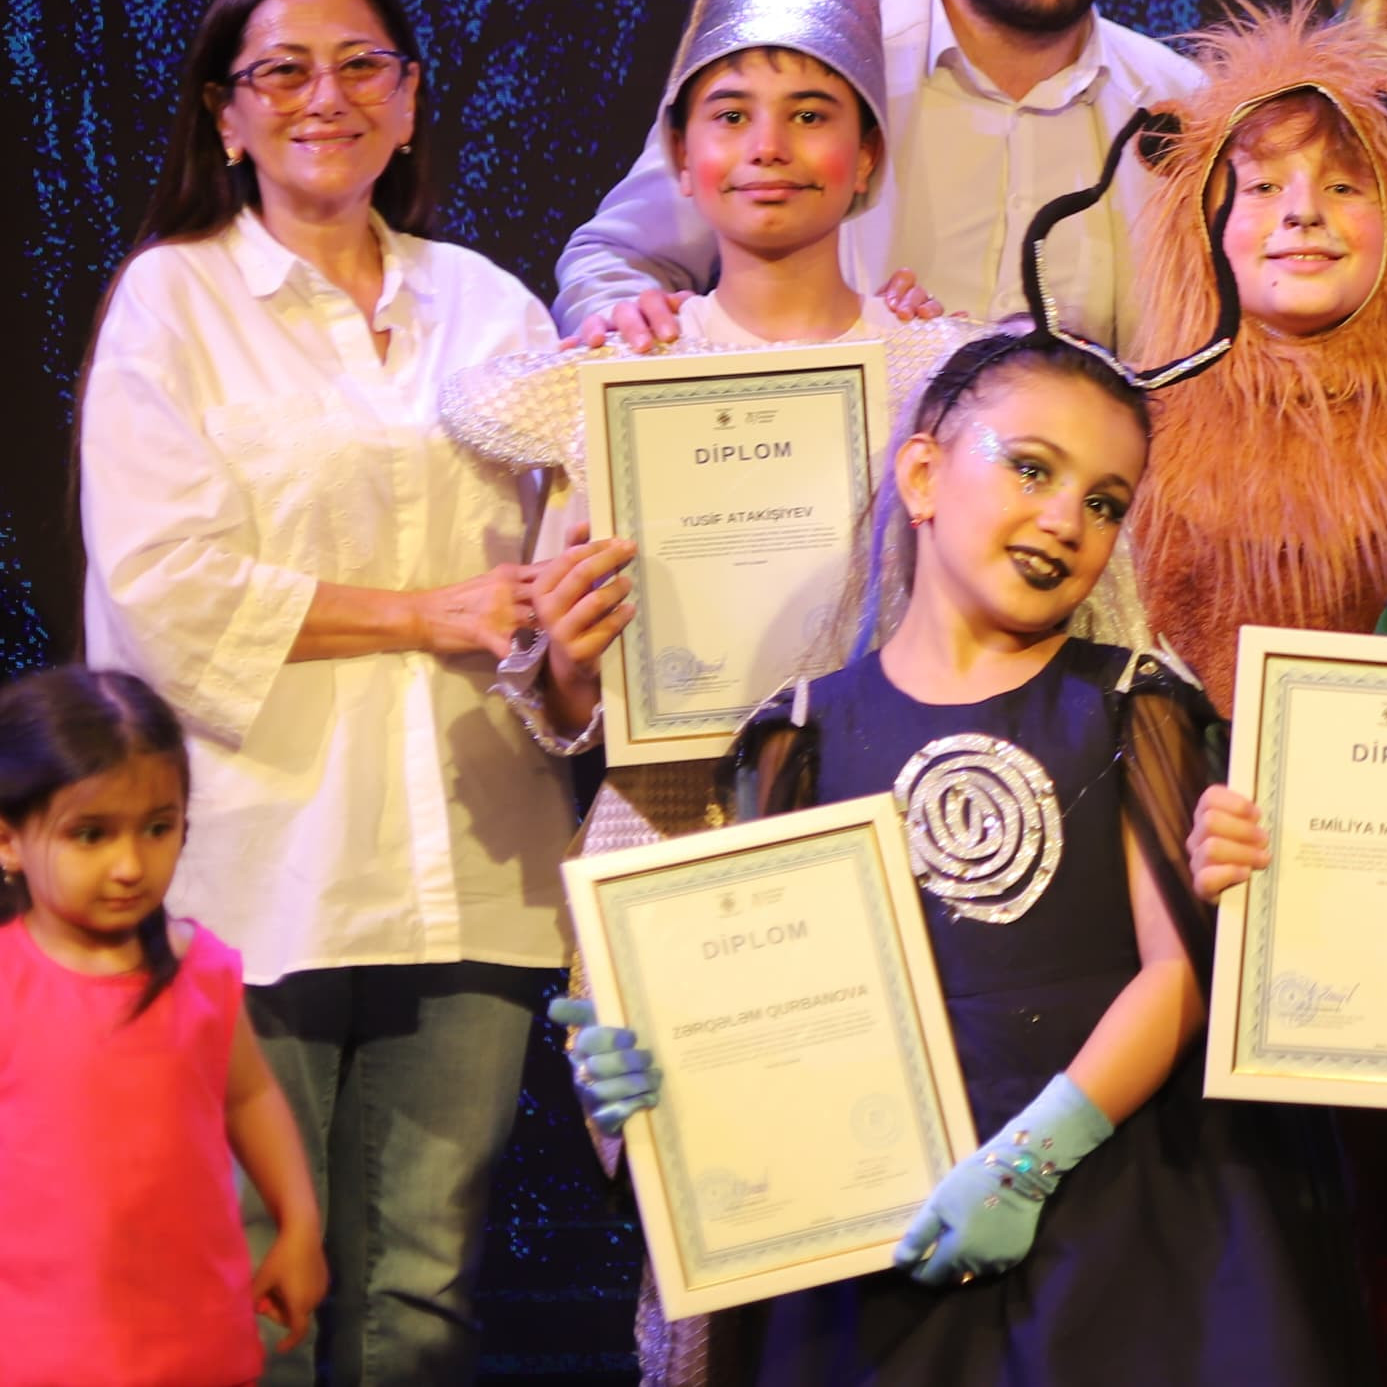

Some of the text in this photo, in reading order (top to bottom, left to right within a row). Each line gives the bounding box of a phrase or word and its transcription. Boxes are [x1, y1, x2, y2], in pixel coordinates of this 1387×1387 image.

[694, 441, 793, 465] DİPLOM
[680, 506, 814, 528] YUSİF ATAKİŞİYEV
[1308, 816, 1375, 836] EMİLİYA
[702, 919, 810, 961] DİPLOM
[765, 984, 869, 1019] QURBANOVA
